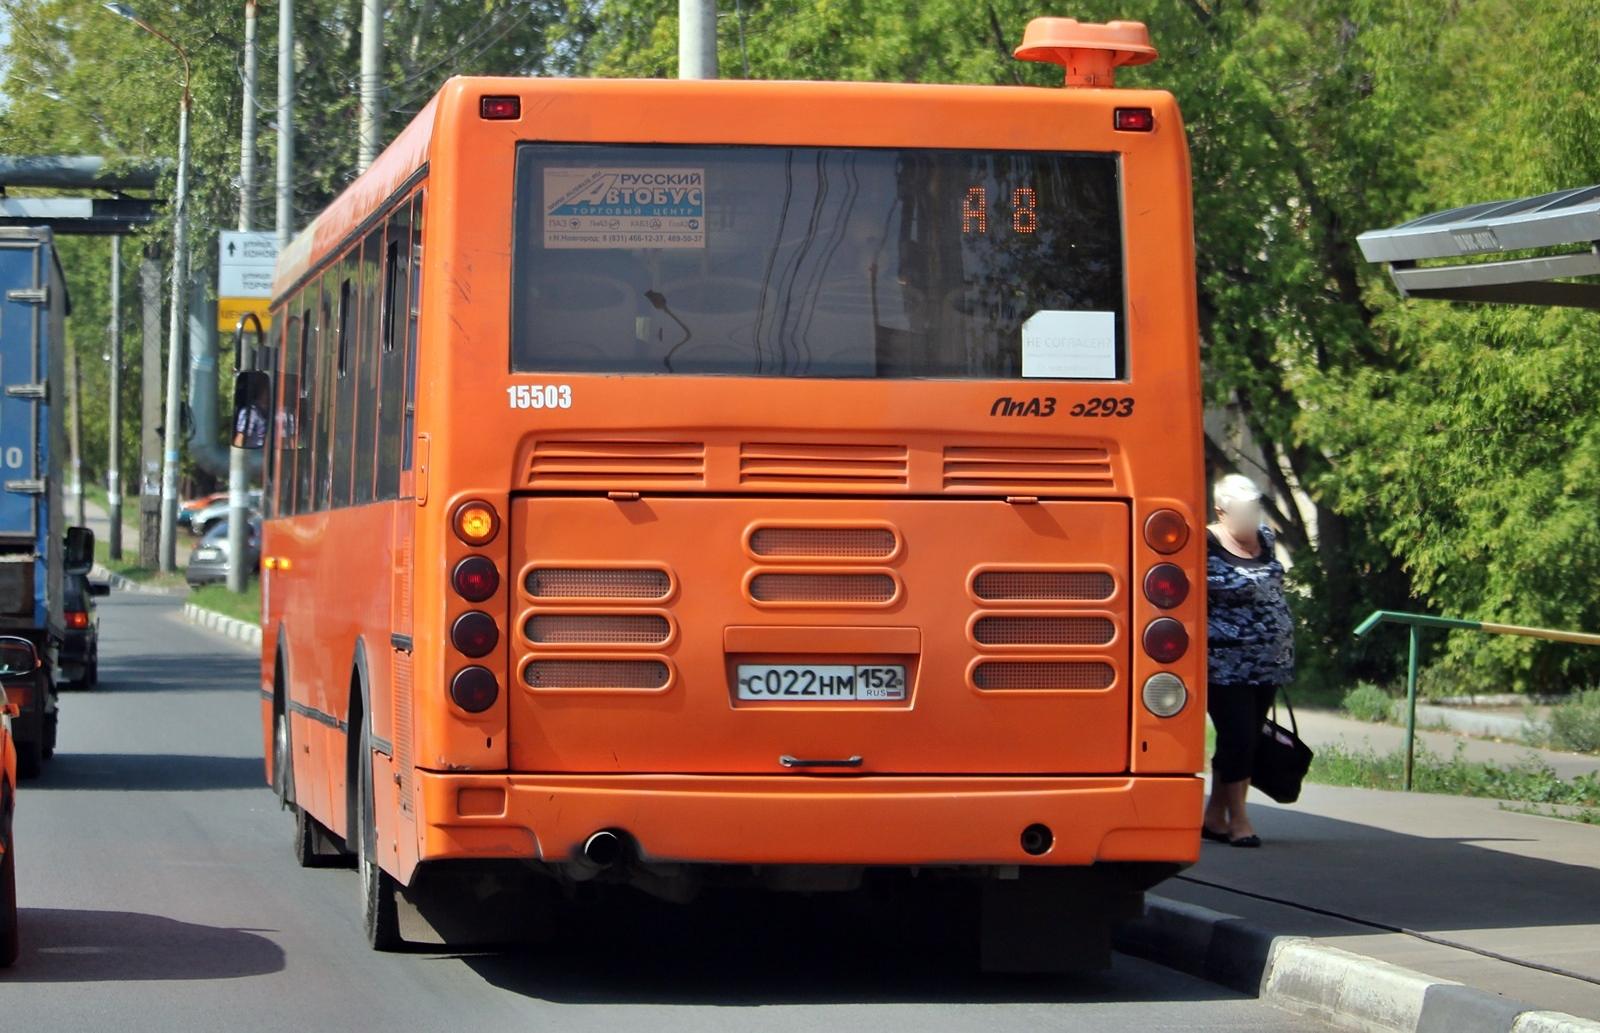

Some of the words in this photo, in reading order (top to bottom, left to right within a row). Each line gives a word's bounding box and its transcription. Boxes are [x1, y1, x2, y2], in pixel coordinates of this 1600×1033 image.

[620, 172, 702, 185] РУССКИЙ
[653, 207, 694, 216] ЦЕНТР
[1013, 187, 1036, 233] 8
[506, 384, 572, 409] 15503
[858, 668, 898, 689] 152
[866, 689, 886, 697] RUS
